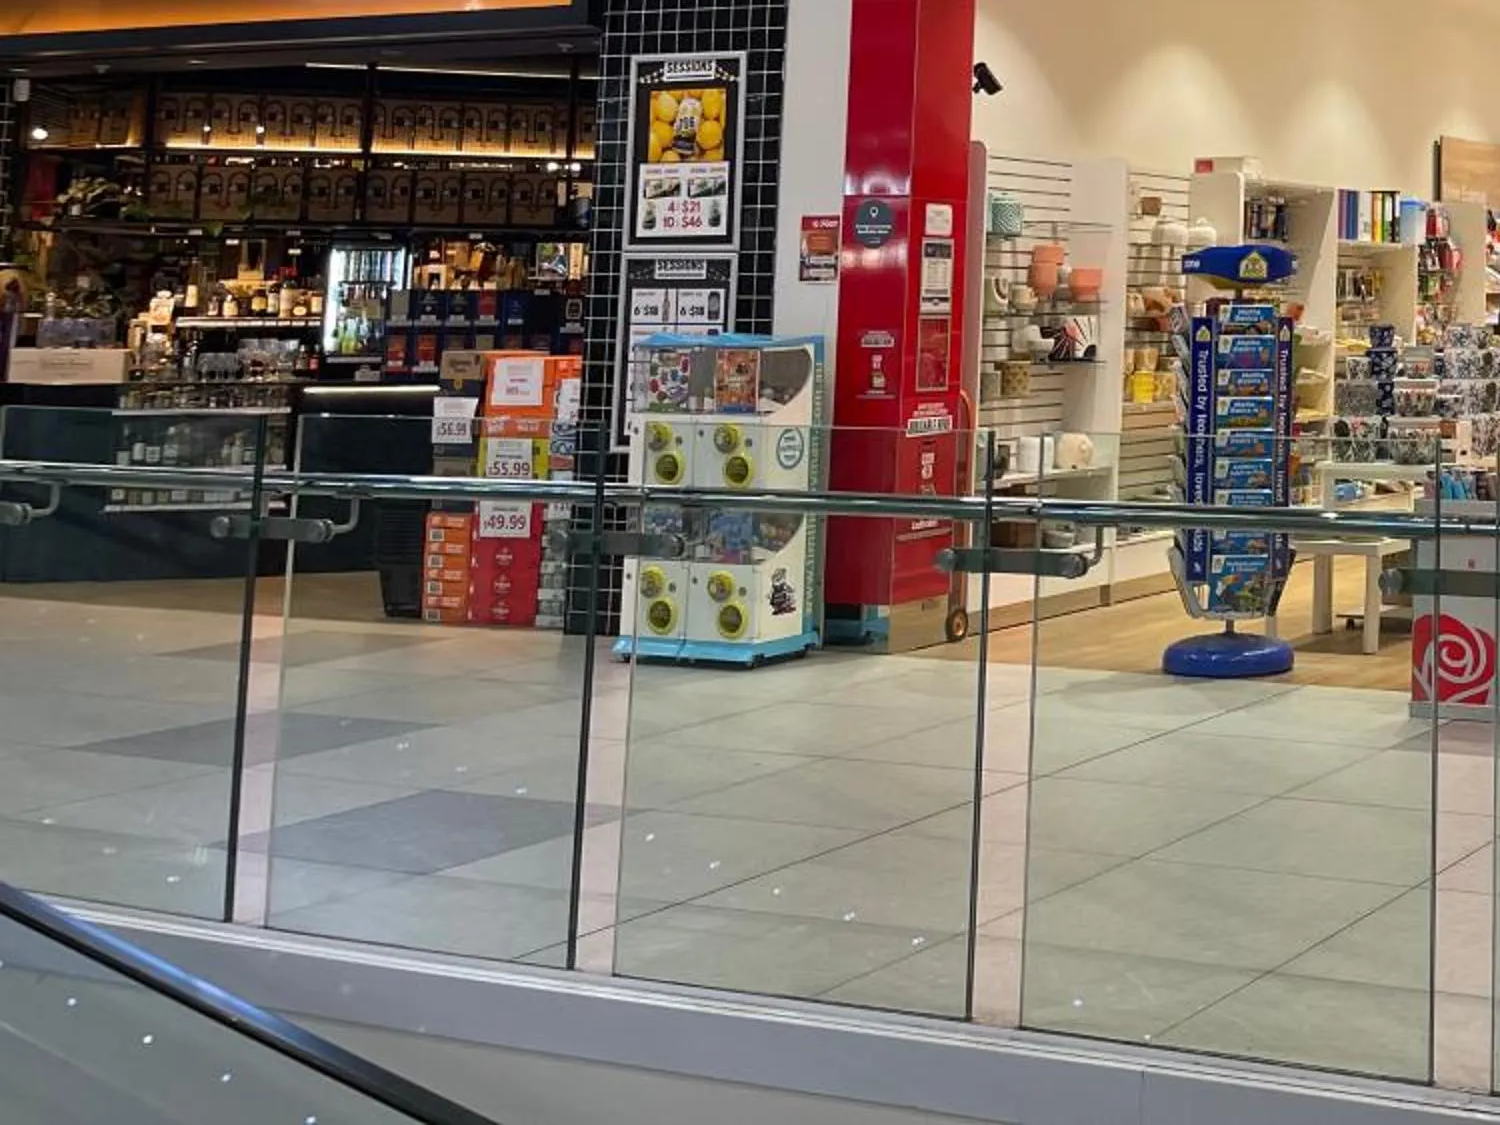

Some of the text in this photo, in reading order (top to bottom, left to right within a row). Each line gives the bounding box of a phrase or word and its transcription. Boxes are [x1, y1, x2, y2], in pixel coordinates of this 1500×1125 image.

[667, 59, 713, 73] SESSIONS
[658, 259, 705, 271] SESSIONS
[1197, 350, 1208, 391] Trusted
[1195, 396, 1208, 411] by
[488, 461, 530, 475] $55.99
[483, 514, 527, 529] $49.99
